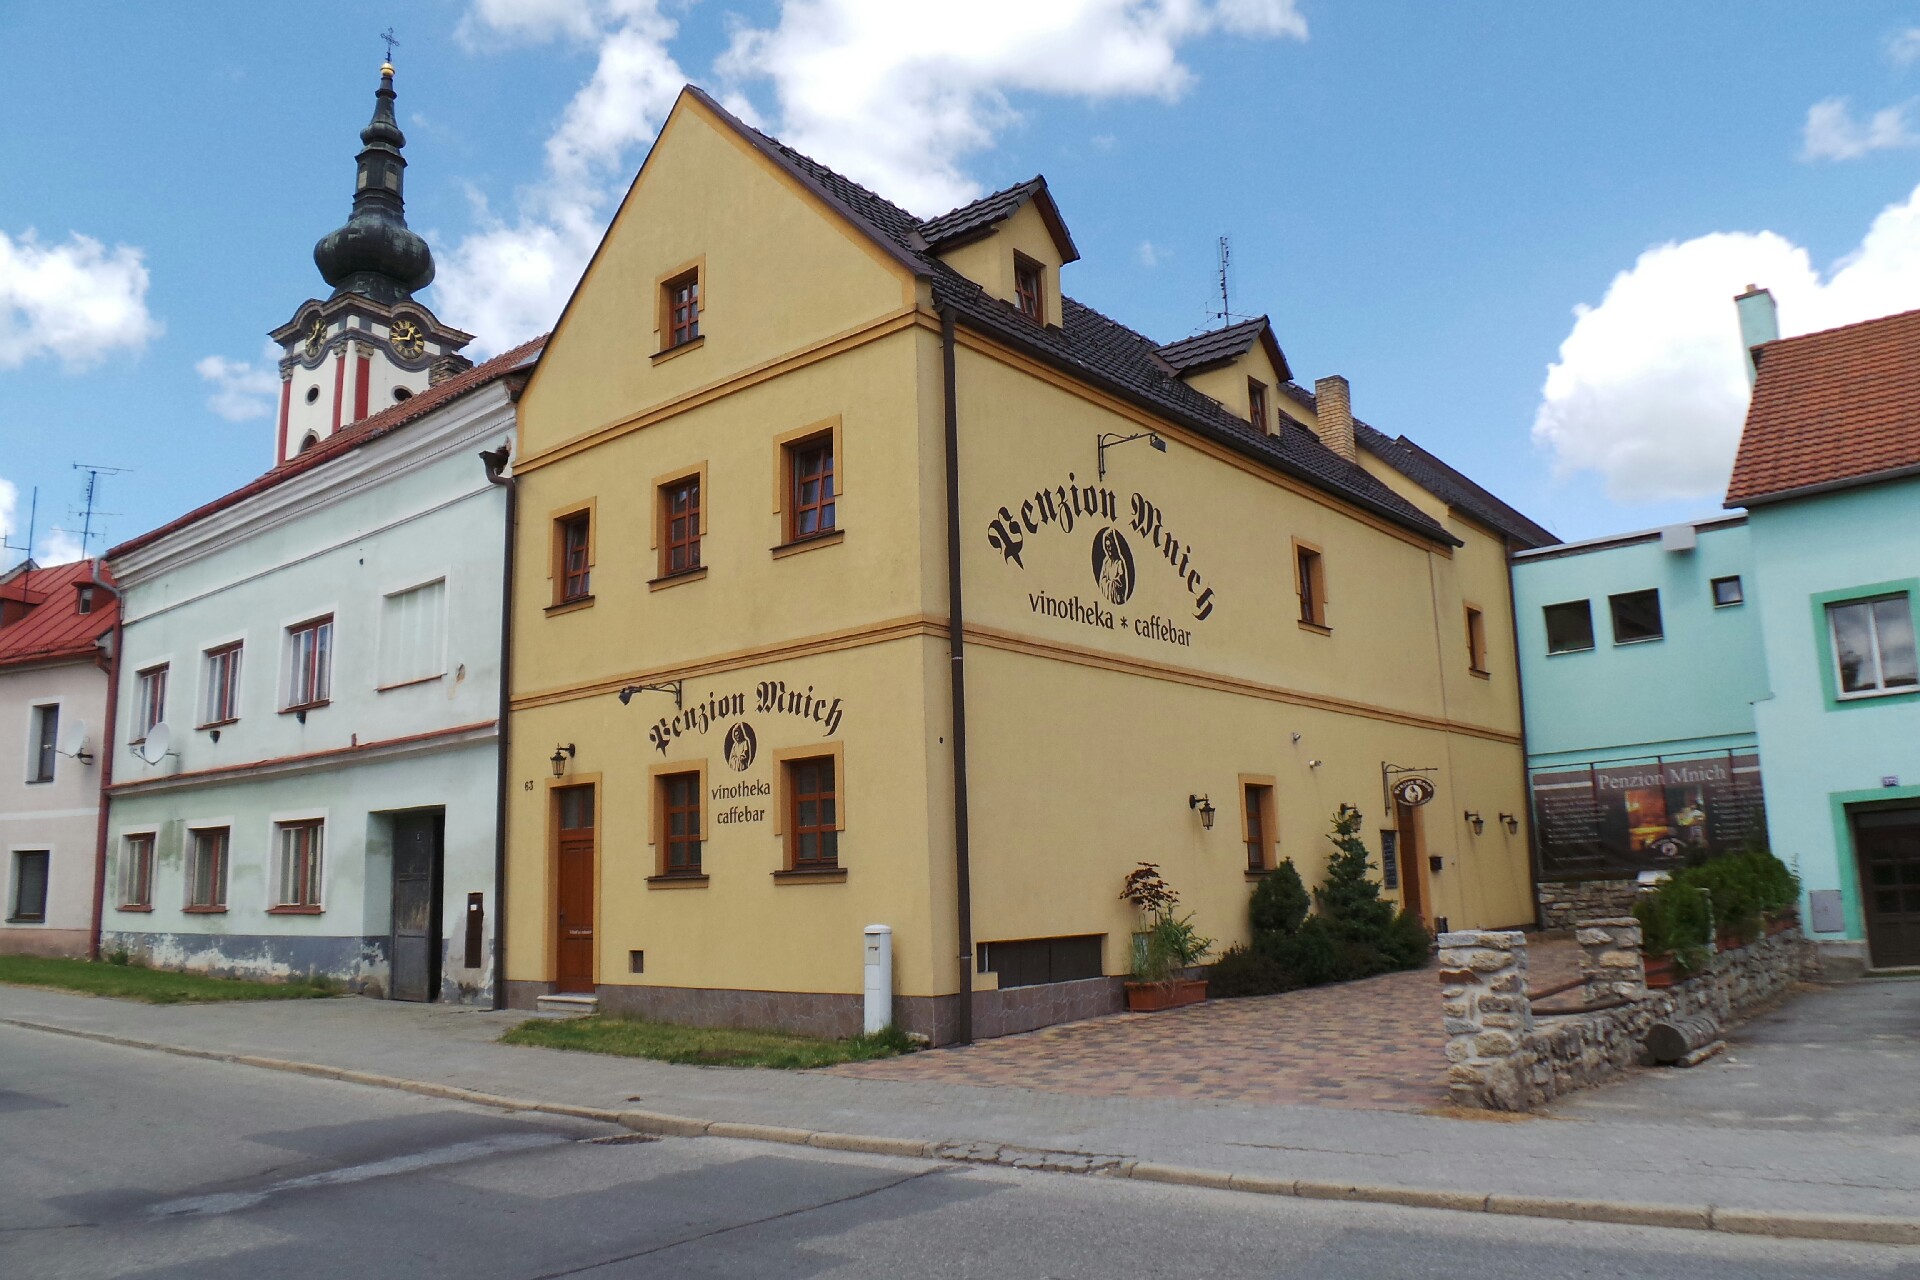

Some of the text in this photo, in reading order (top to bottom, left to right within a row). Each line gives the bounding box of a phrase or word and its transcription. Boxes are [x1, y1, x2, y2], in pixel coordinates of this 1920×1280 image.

[988, 472, 1215, 621] Penzion Mnich
[1029, 590, 1191, 647] vinotheka caffebar
[650, 680, 844, 757] Penzion Mnich
[711, 779, 771, 800] vinotheka
[1598, 764, 1726, 790] Penzion Mnich
[717, 806, 765, 824] caffebar
